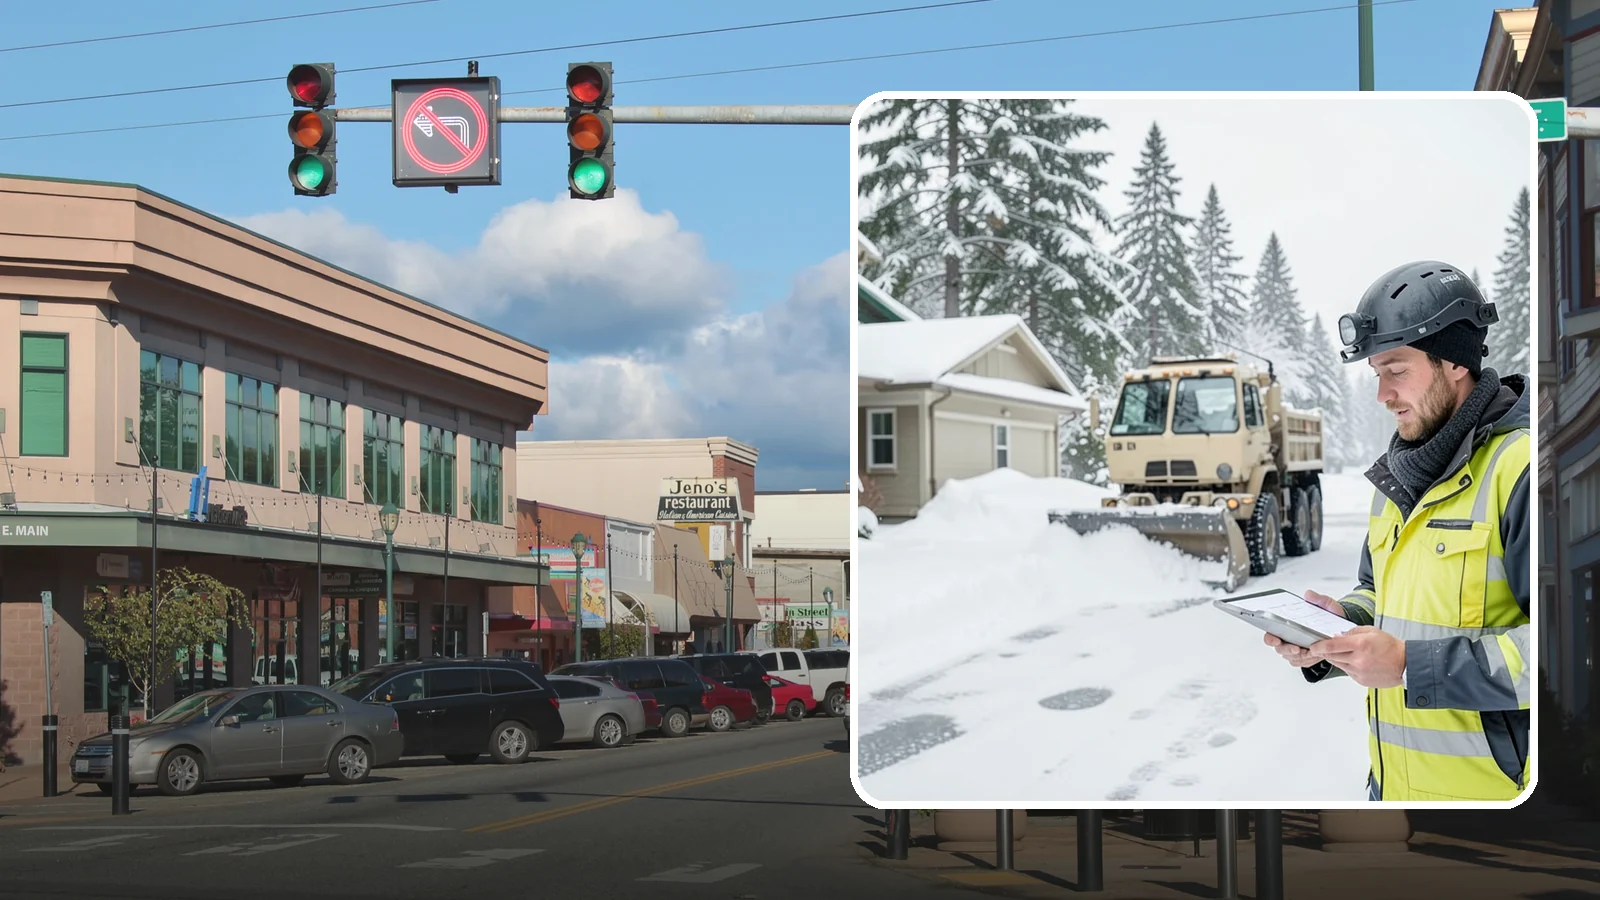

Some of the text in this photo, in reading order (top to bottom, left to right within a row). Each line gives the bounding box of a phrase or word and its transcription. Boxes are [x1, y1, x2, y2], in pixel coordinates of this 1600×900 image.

[670, 480, 727, 494] Jeno's
[665, 496, 731, 509] restaurant
[659, 510, 681, 519] Italian
[686, 509, 714, 519] American
[715, 509, 737, 519] Cuisine
[2, 525, 49, 536] E. MAIN
[797, 608, 828, 617] Street
